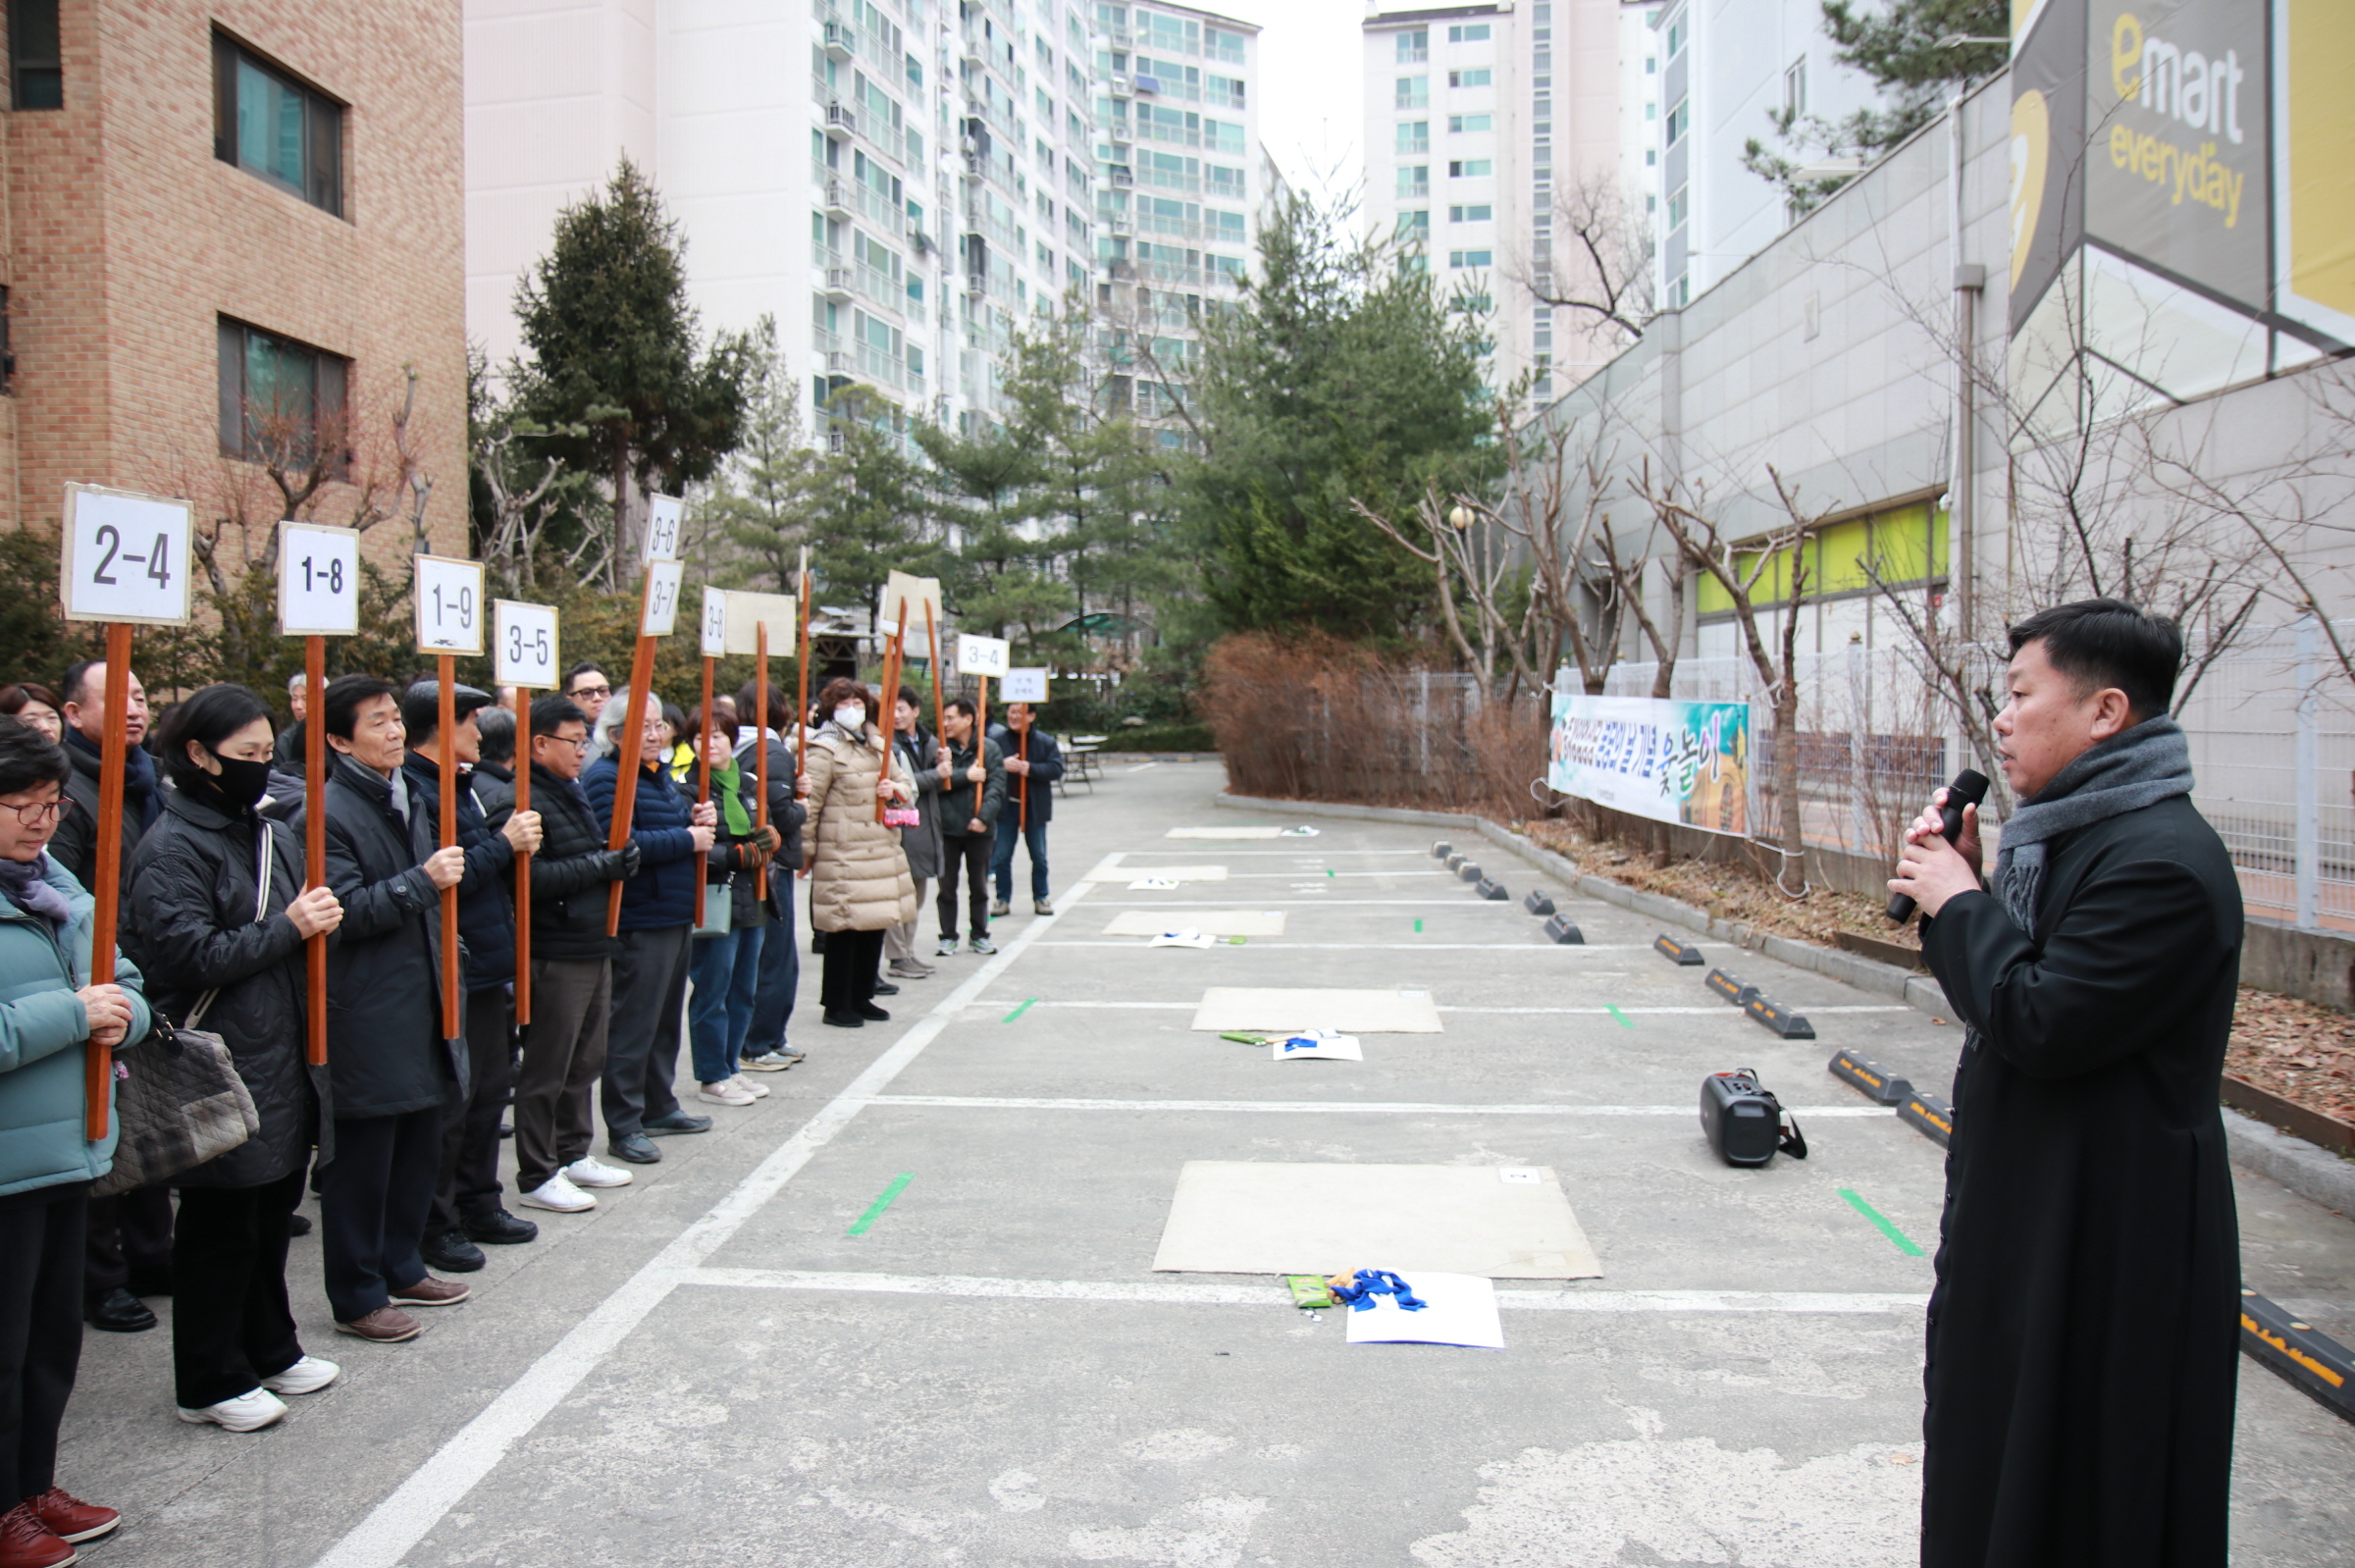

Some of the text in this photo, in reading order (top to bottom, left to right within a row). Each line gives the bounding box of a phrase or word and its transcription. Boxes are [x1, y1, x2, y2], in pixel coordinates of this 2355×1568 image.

[2113, 12, 2244, 145] emart
[2111, 122, 2245, 230] everyday
[652, 516, 675, 553] 3-6
[93, 524, 172, 590] 2-4
[301, 555, 344, 594] 1-8
[433, 583, 473, 629] 1-9
[653, 580, 676, 615] 3-7
[707, 605, 723, 639] 3-8
[509, 624, 549, 666] 3-5
[968, 646, 999, 666] 3-4
[1656, 713, 1719, 798] 윷놀이
